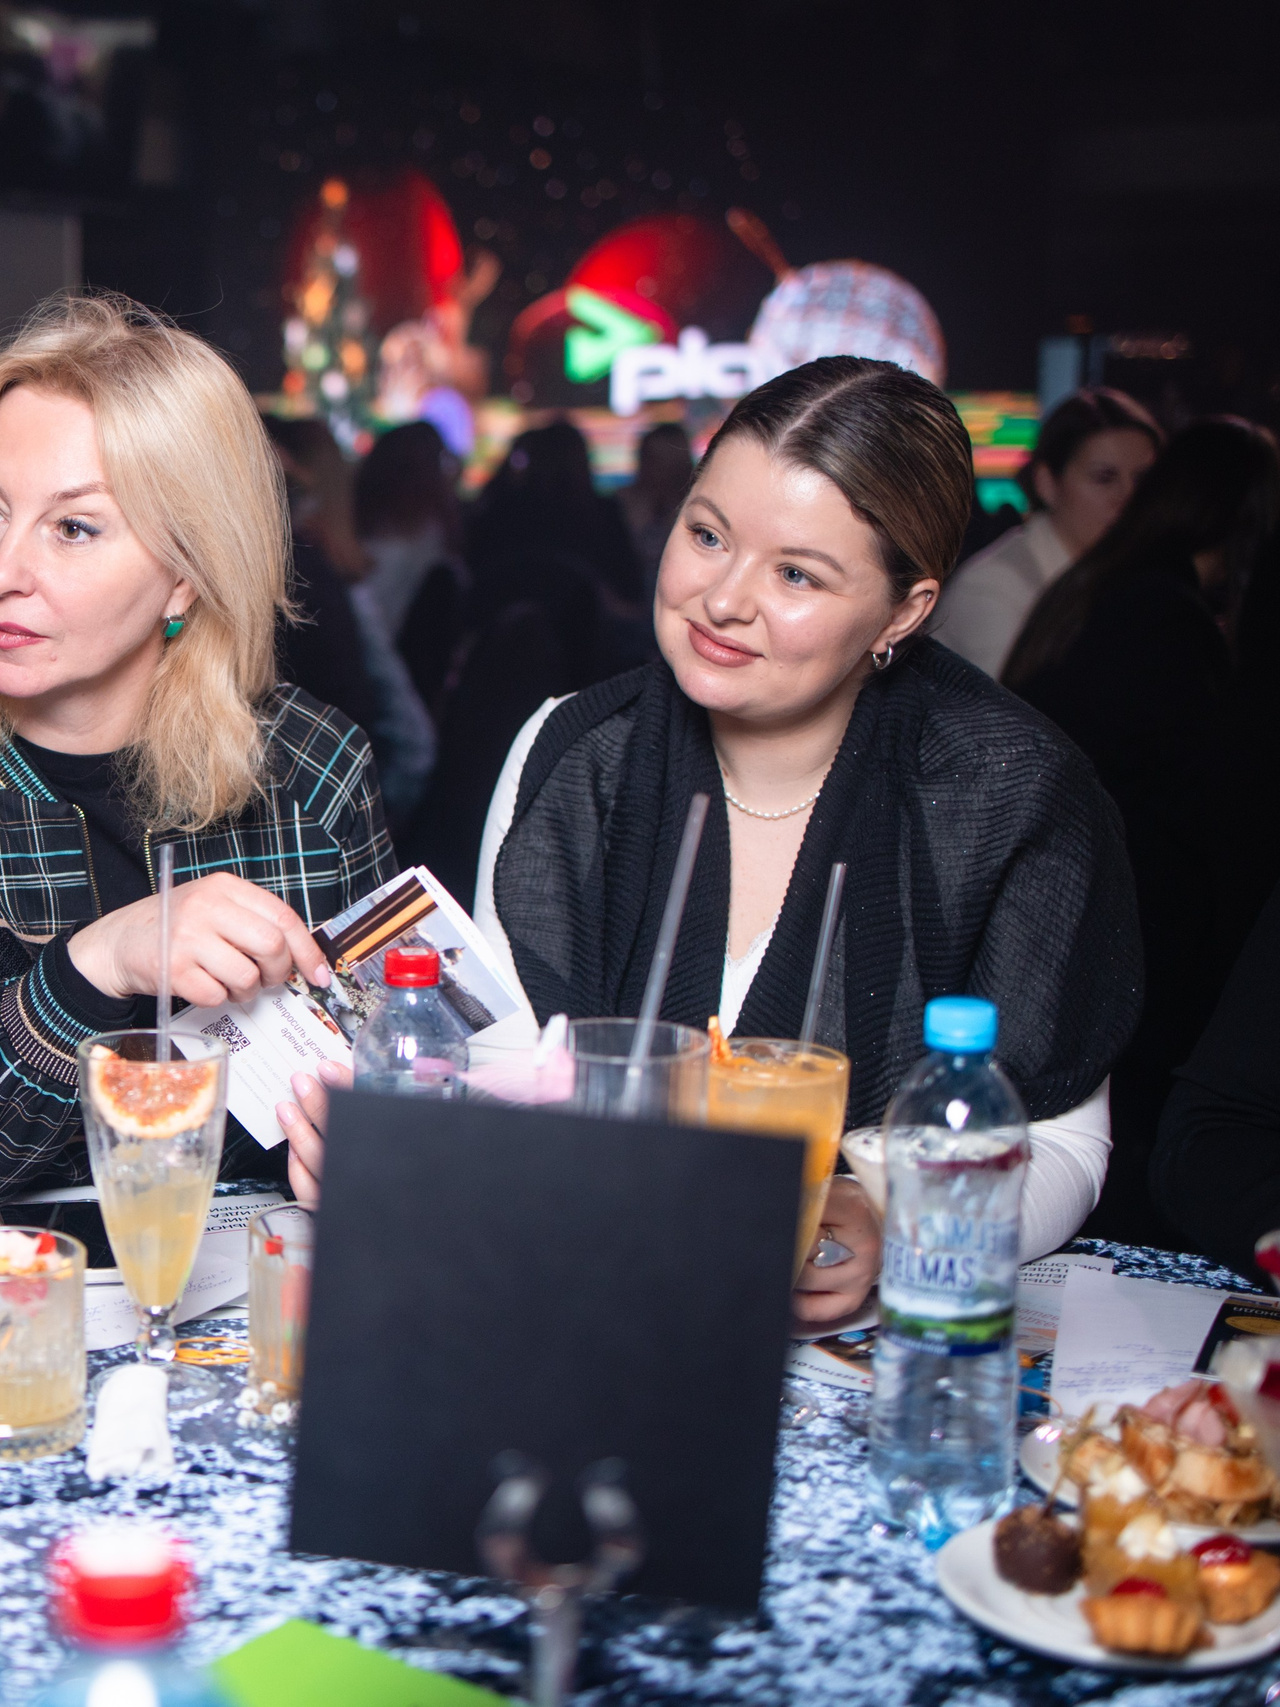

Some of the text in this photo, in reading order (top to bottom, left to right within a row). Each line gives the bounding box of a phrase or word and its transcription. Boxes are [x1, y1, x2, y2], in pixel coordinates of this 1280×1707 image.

[609, 325, 760, 416] pla
[272, 997, 329, 1062] Запросить услов
[280, 1027, 309, 1058] аренды
[885, 1240, 976, 1289] TELMAS
